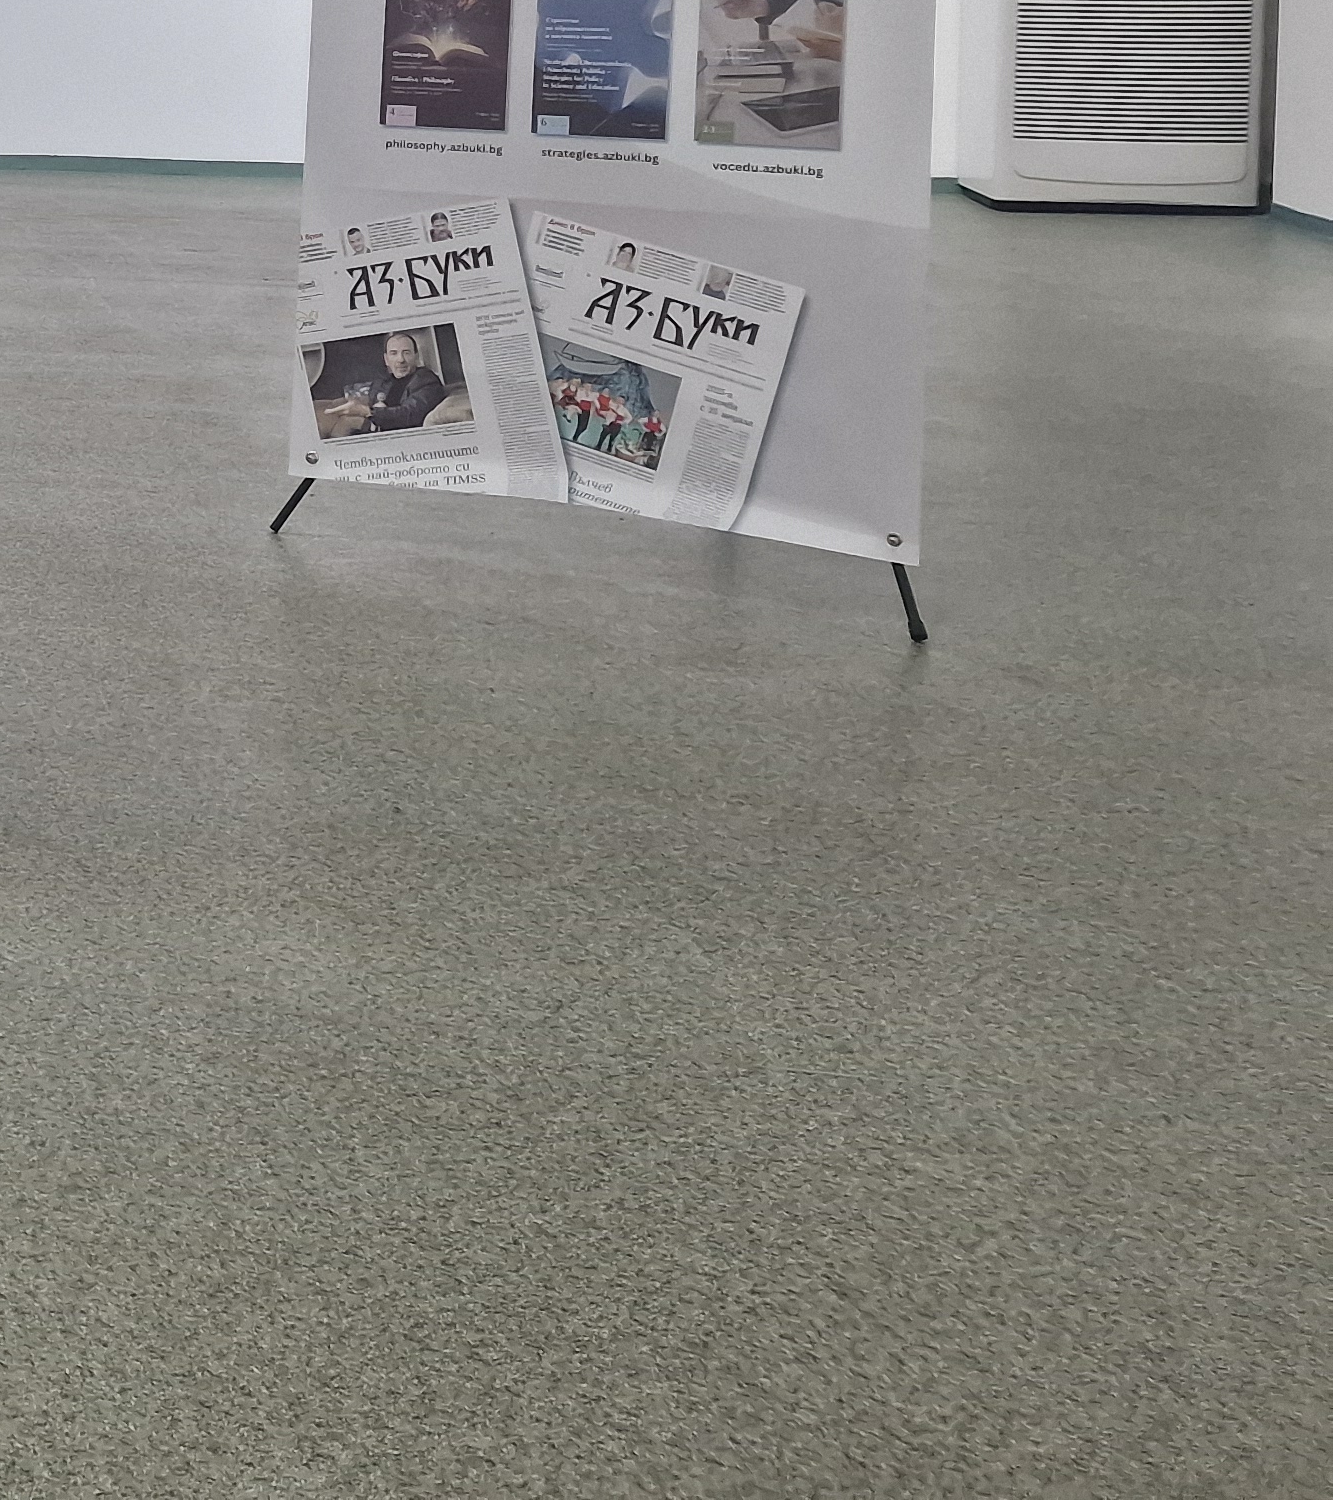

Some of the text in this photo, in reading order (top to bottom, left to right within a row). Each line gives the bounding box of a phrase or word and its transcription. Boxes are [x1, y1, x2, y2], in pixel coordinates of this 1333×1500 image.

[385, 138, 504, 157] philosophy.azbuki.bg
[541, 148, 660, 166] strategies.azbuki.bg
[712, 160, 824, 179] vocedu.azbuki.bg
[444, 473, 487, 486] TIMSS
